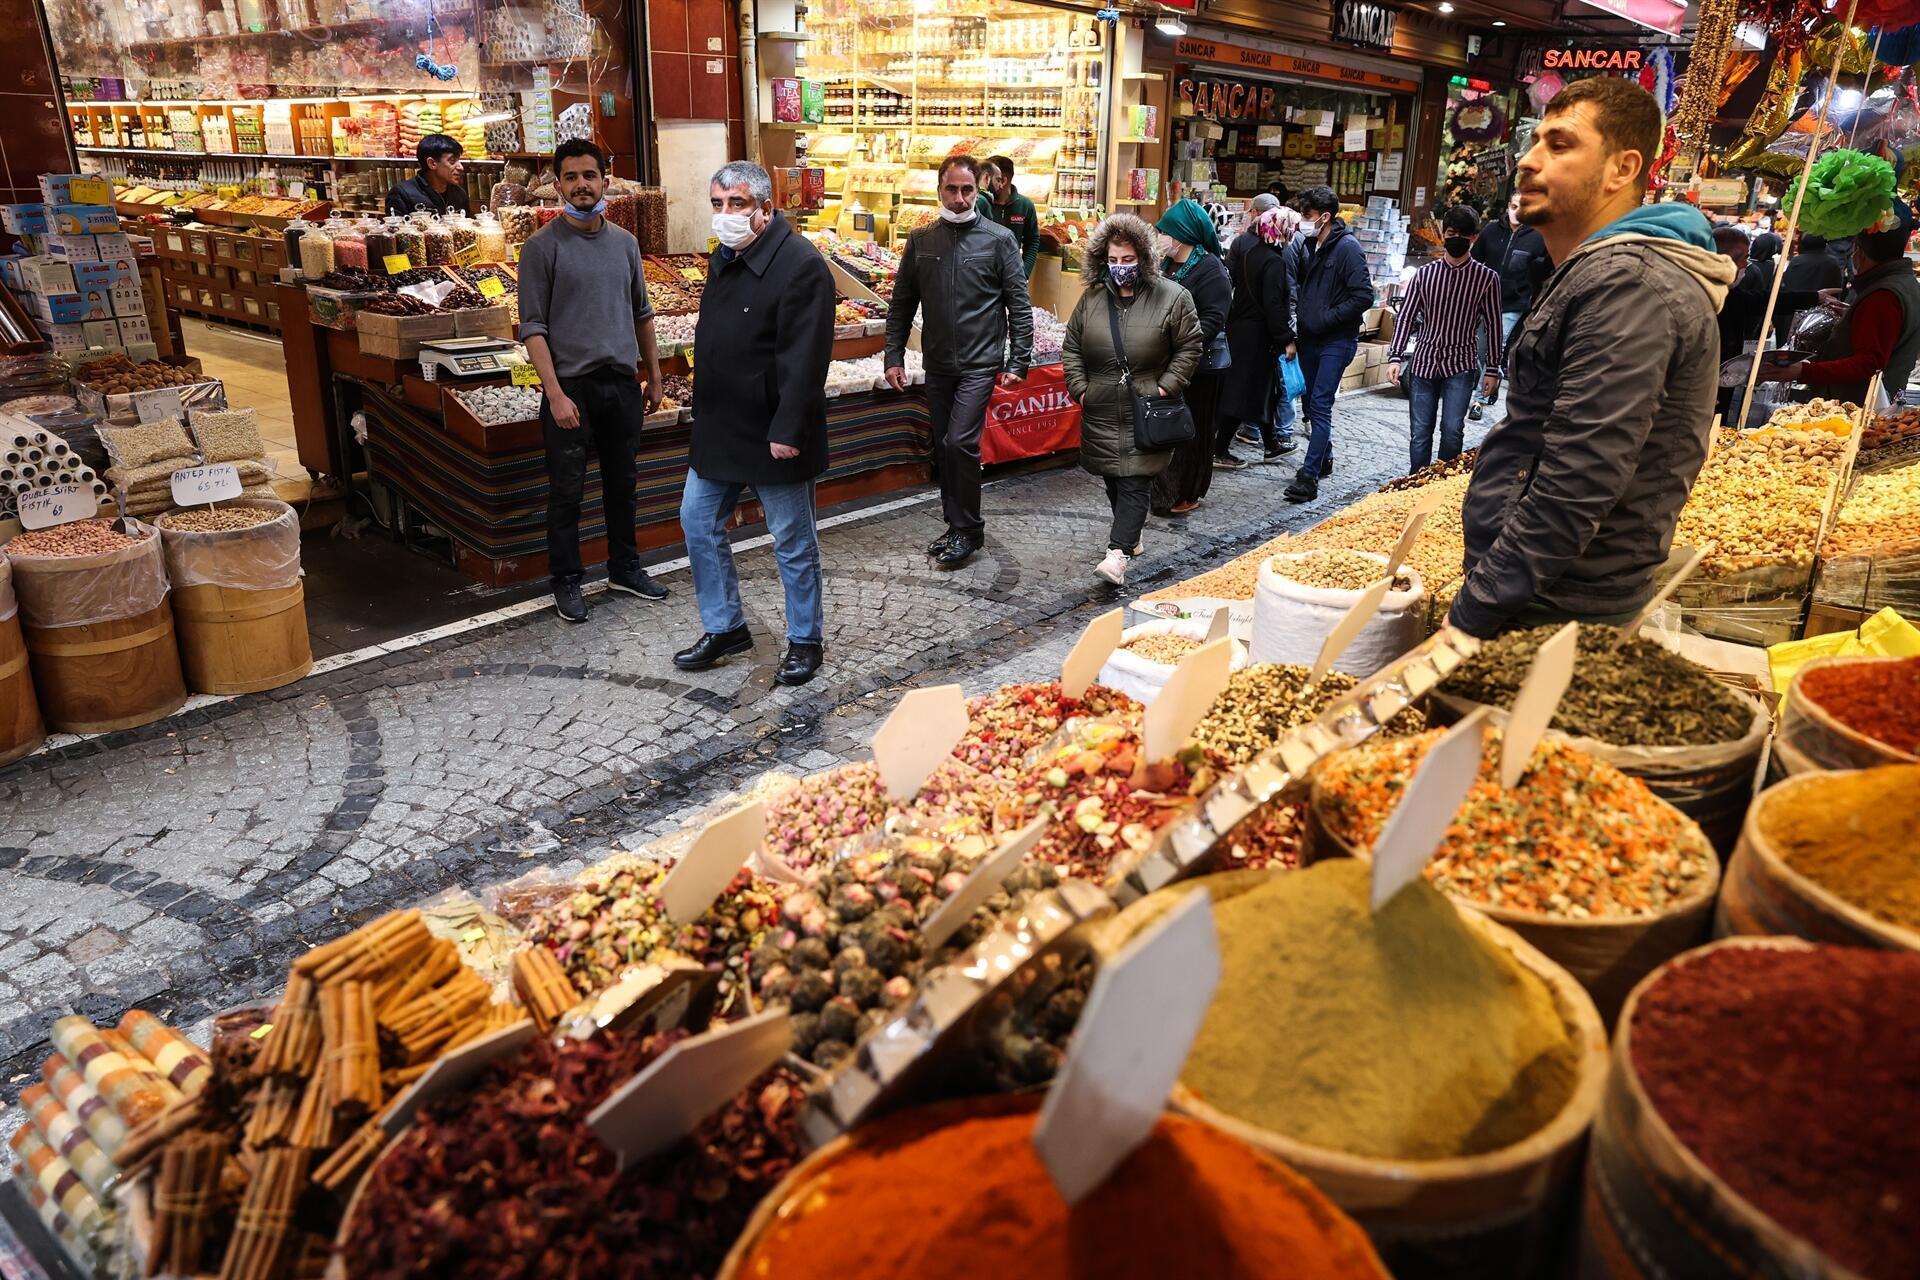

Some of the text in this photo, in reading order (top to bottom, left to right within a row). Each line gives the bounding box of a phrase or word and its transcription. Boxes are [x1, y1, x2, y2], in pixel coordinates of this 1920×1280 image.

[1340, 0, 1396, 47] SANCAR
[1179, 42, 1216, 58] SANCAR
[1240, 51, 1272, 66] SANCAR
[1544, 50, 1641, 69] SANCAR
[1292, 59, 1320, 74] SANCAR
[1340, 68, 1366, 81] SANCAR
[782, 88, 798, 97] TEA
[808, 90, 821, 99] TEA
[1179, 79, 1276, 120] SANCAR
[809, 176, 823, 185] TEA
[992, 388, 1073, 420] GANİK
[174, 470, 204, 483] ANTEP
